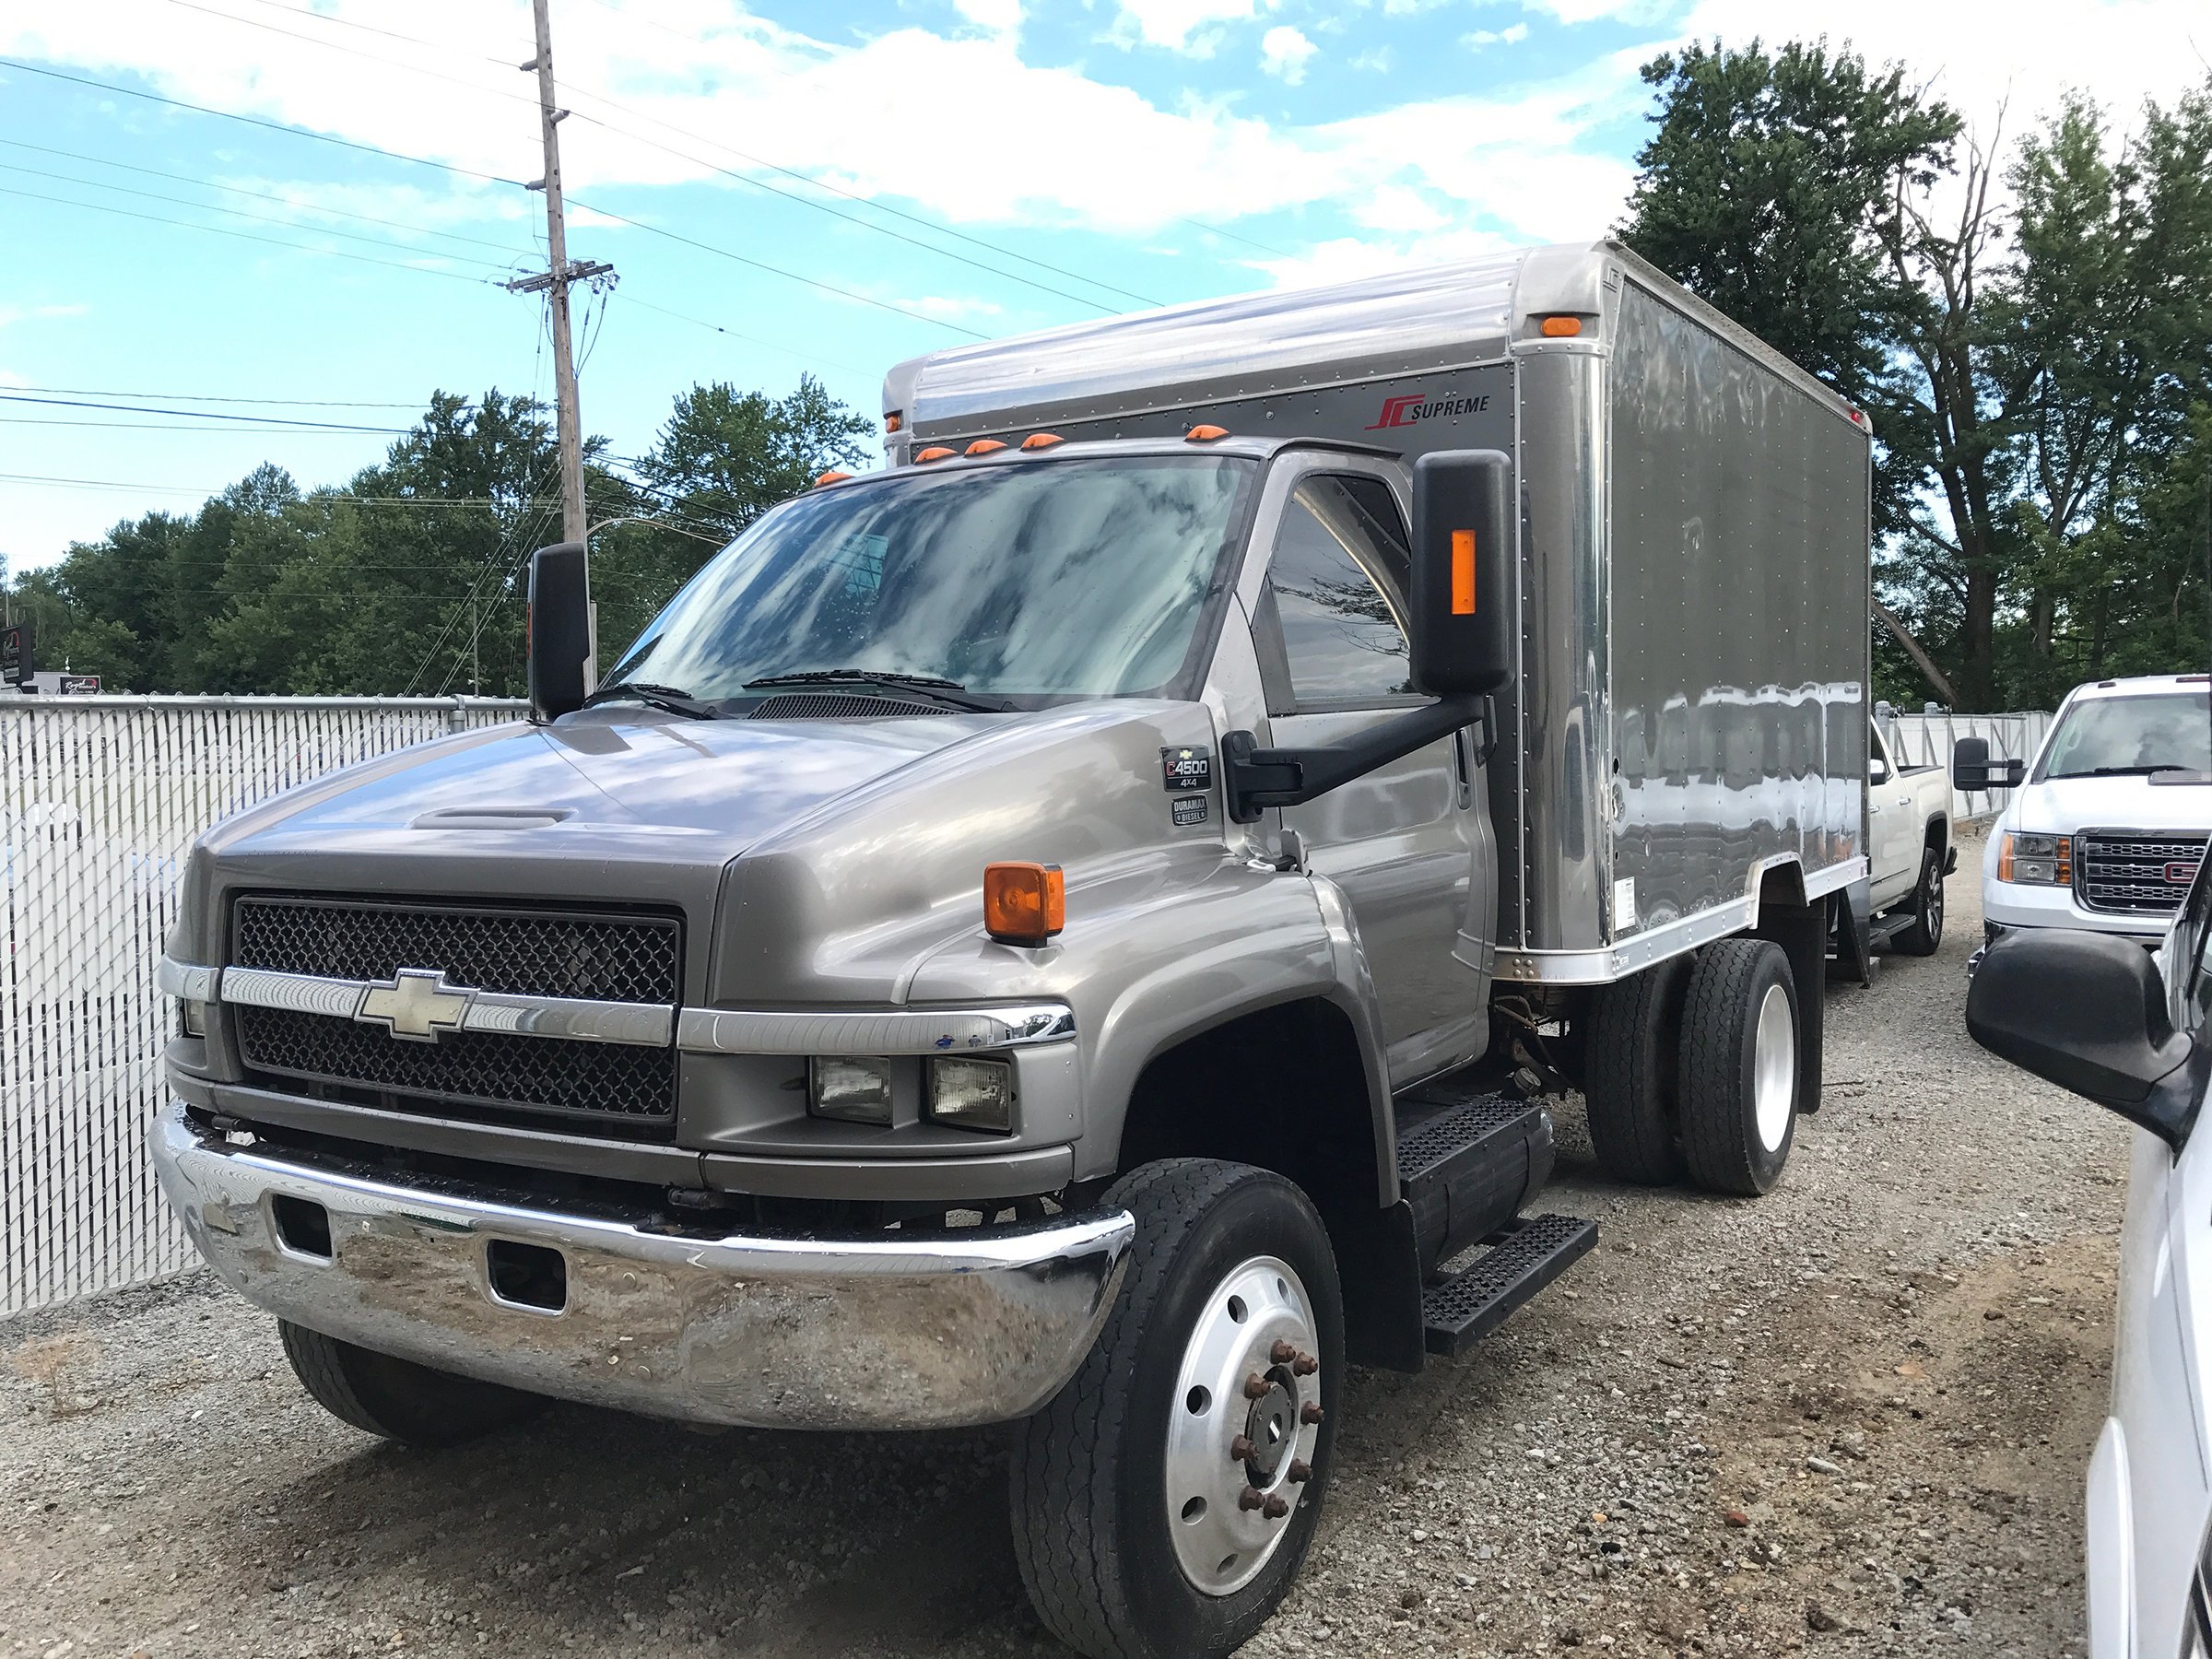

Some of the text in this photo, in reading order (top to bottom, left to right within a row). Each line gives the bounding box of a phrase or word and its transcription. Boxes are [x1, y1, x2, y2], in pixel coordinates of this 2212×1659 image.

[1411, 395, 1490, 420] SUPREME
[1166, 759, 1207, 776] C4500
[1173, 798, 1206, 812] DURAMAX
[1181, 811, 1201, 822] DIESEL
